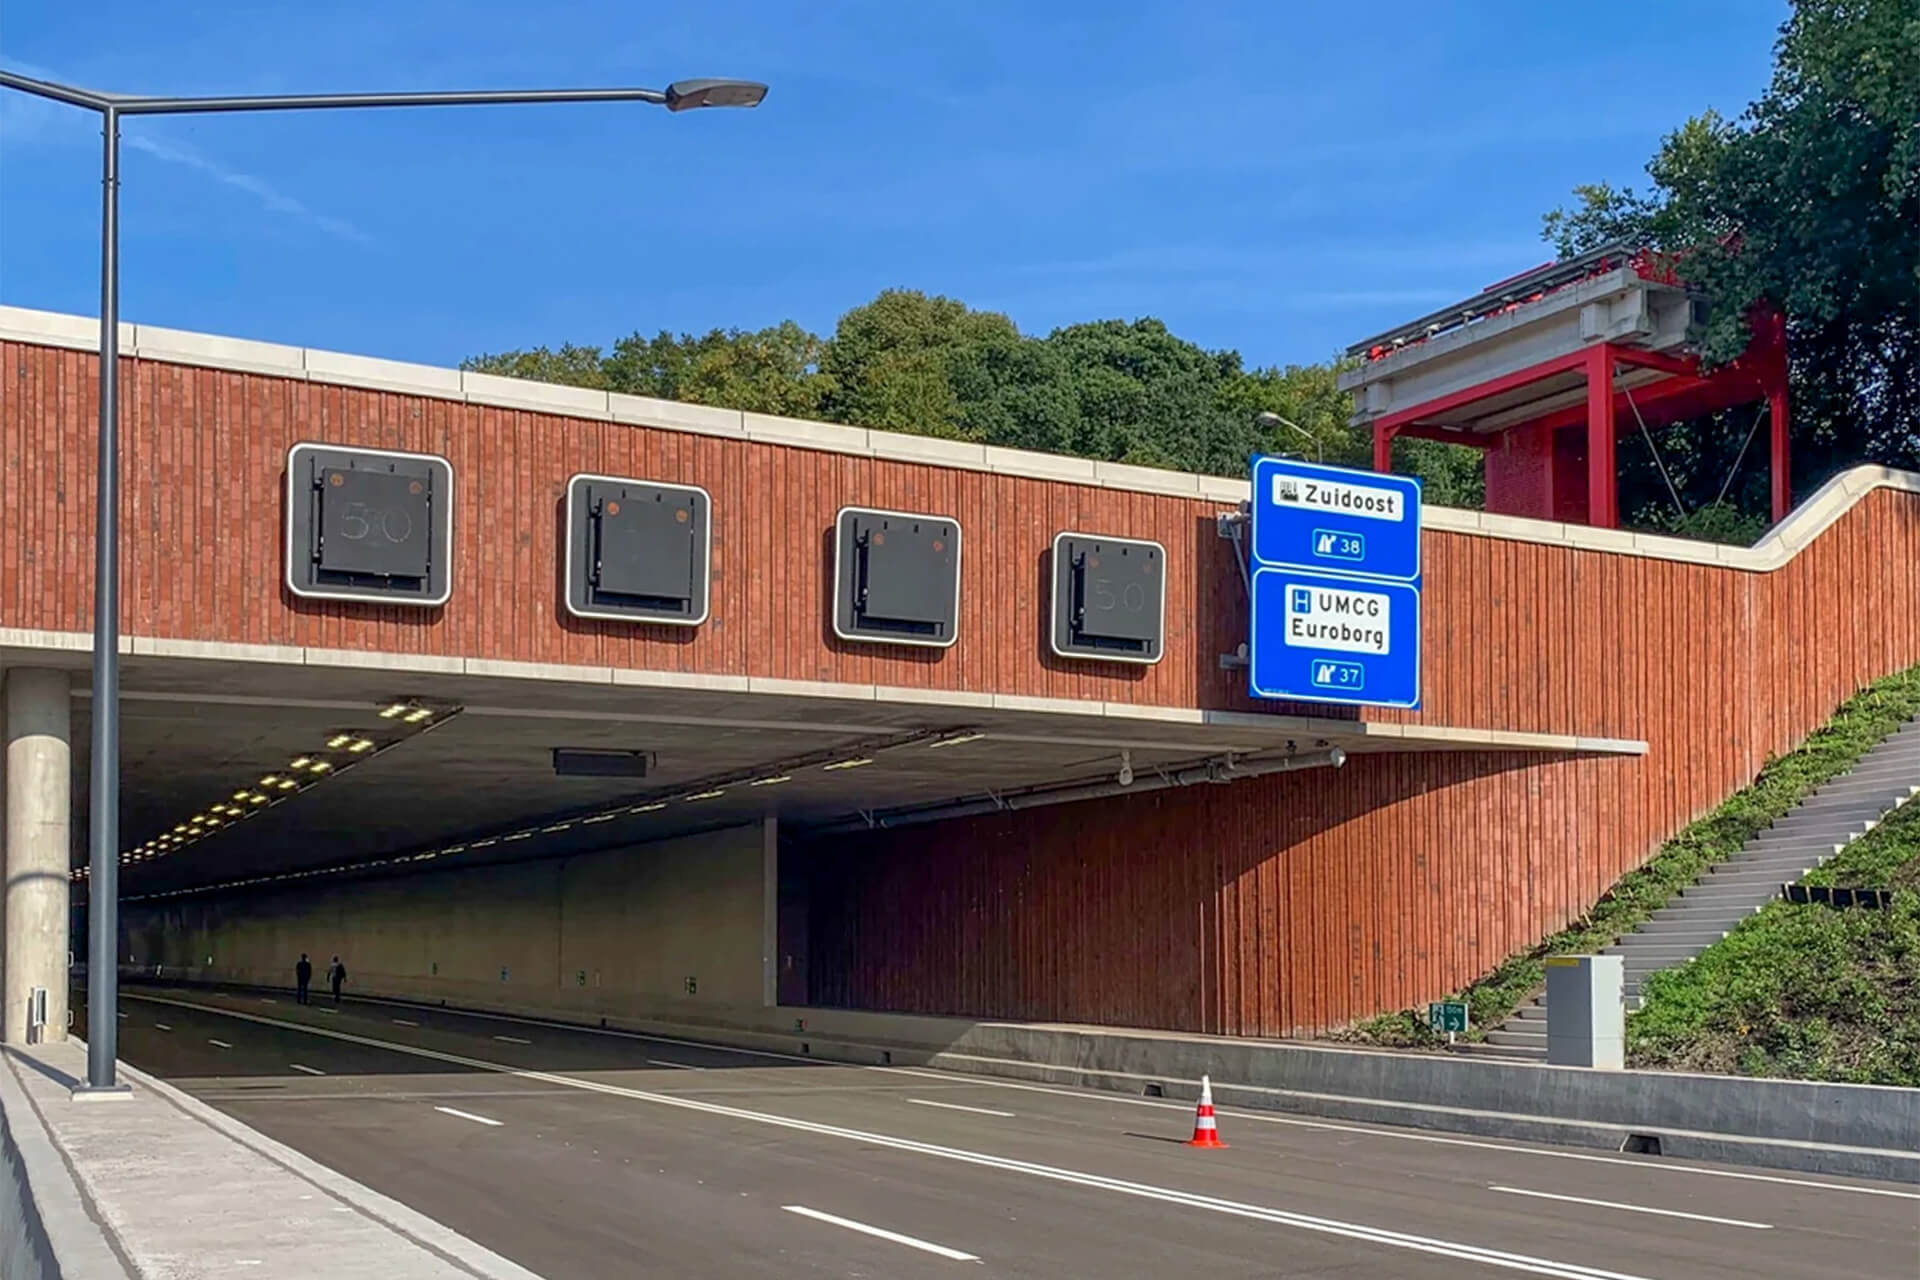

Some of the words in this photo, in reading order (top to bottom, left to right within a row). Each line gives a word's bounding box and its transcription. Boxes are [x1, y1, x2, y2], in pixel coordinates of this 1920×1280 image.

[1305, 484, 1395, 514] Zuidoost
[340, 502, 412, 543] 50
[1340, 537, 1361, 554] 38
[1097, 579, 1145, 612] 50
[1319, 593, 1379, 617] UMCG
[1292, 618, 1384, 650] Euroborg
[1339, 668, 1359, 683] 37
